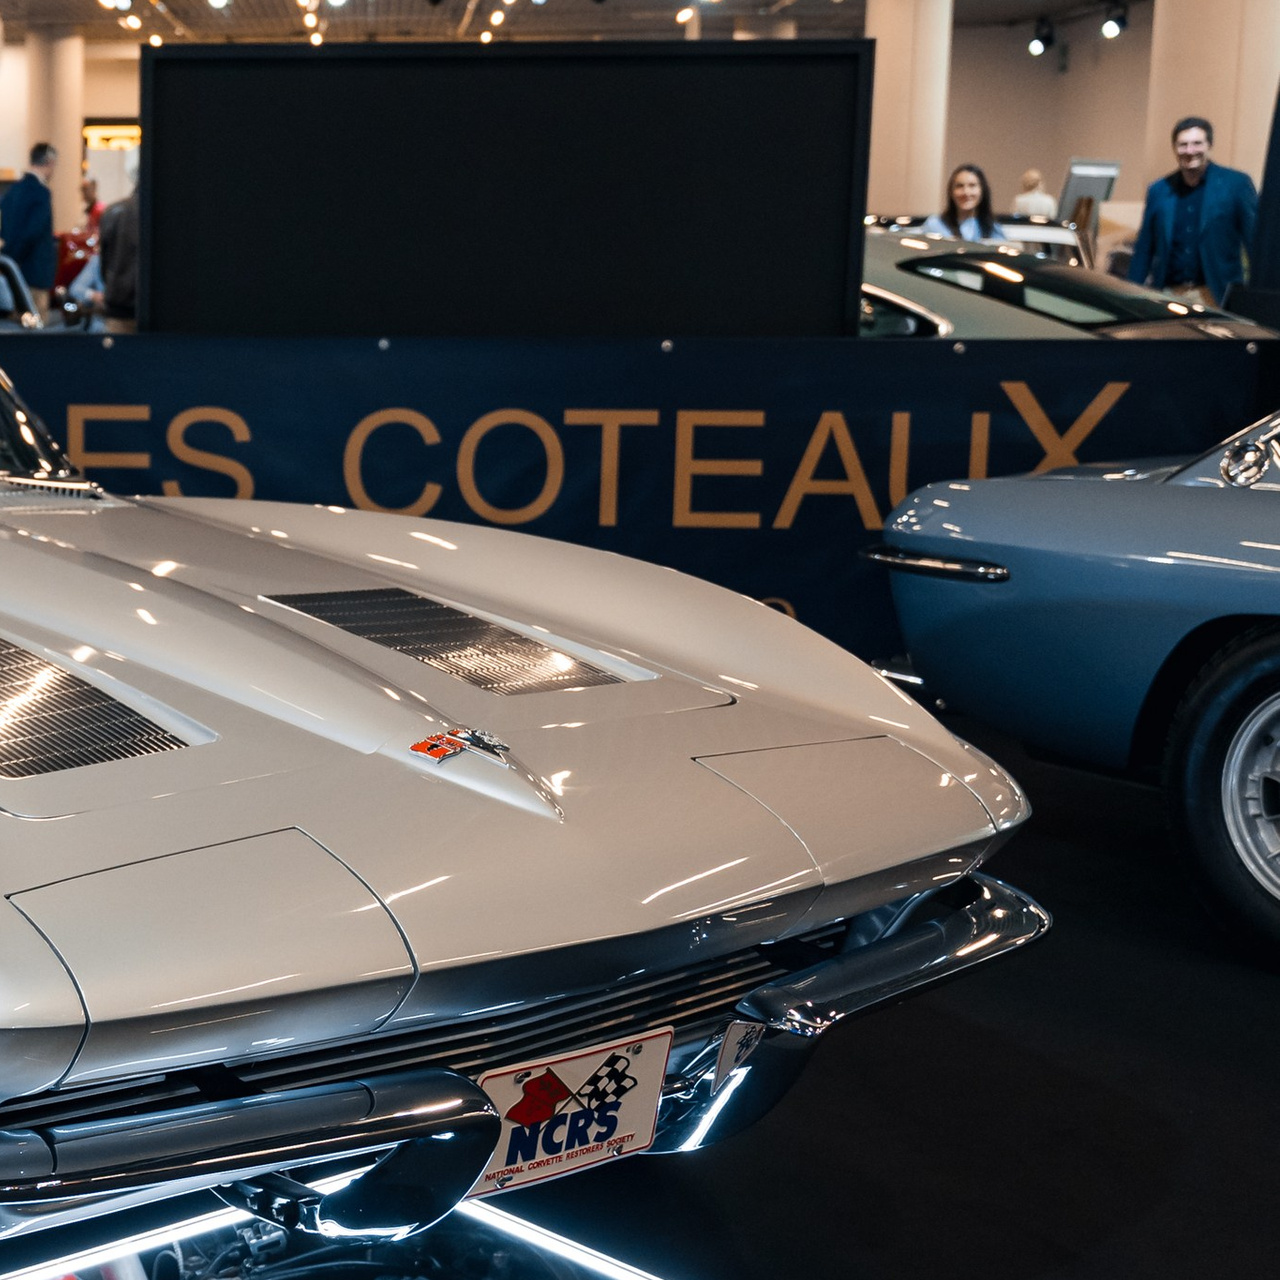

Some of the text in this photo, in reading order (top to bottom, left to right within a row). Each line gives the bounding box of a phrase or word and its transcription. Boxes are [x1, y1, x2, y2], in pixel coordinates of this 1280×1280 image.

[343, 381, 1130, 530] COTEAUX
[485, 1132, 636, 1182] NATIONAL CORVETTE RESTORERS SOCIETY
[505, 1101, 622, 1167] NCRS
